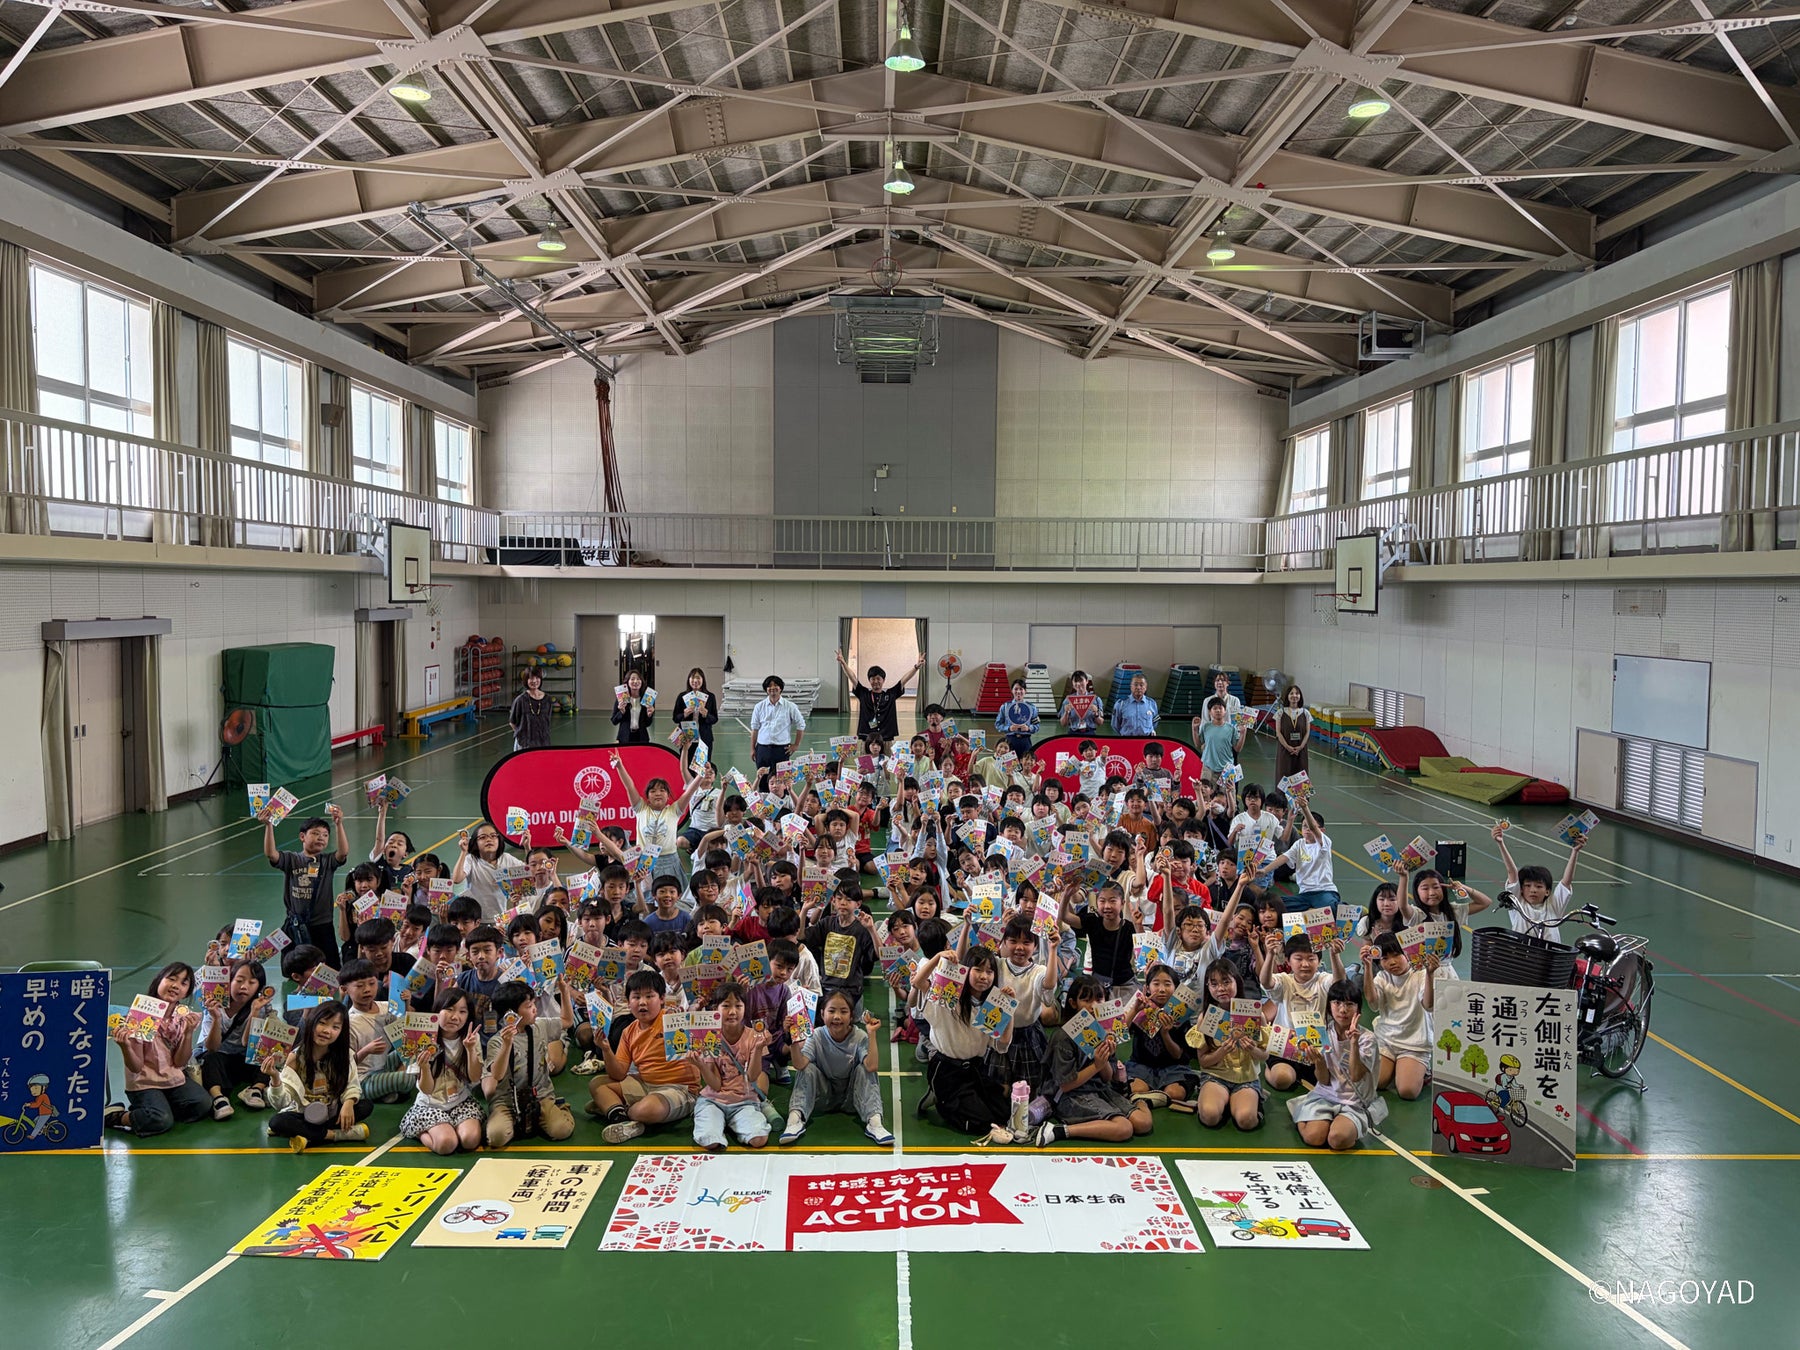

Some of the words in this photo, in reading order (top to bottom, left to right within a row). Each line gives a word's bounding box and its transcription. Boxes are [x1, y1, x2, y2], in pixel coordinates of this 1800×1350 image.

[50, 979, 60, 1000] はや
[21, 979, 48, 1051] 早めの
[1491, 996, 1518, 1047] 通行
[67, 975, 96, 1121] 暗くなったら
[1534, 992, 1561, 1099] 左側端を
[285, 1169, 350, 1215] 歩行者優先
[348, 1169, 390, 1198] 歩道は
[541, 1164, 592, 1213] 車の仲間
[830, 1186, 949, 1207] バスケ
[1045, 1193, 1126, 1204] 日本生命
[1240, 1170, 1280, 1209] を守る
[1272, 1165, 1324, 1210] 一時停止
[358, 1172, 449, 1243] リンリンベル
[802, 1200, 981, 1226] ACTION
